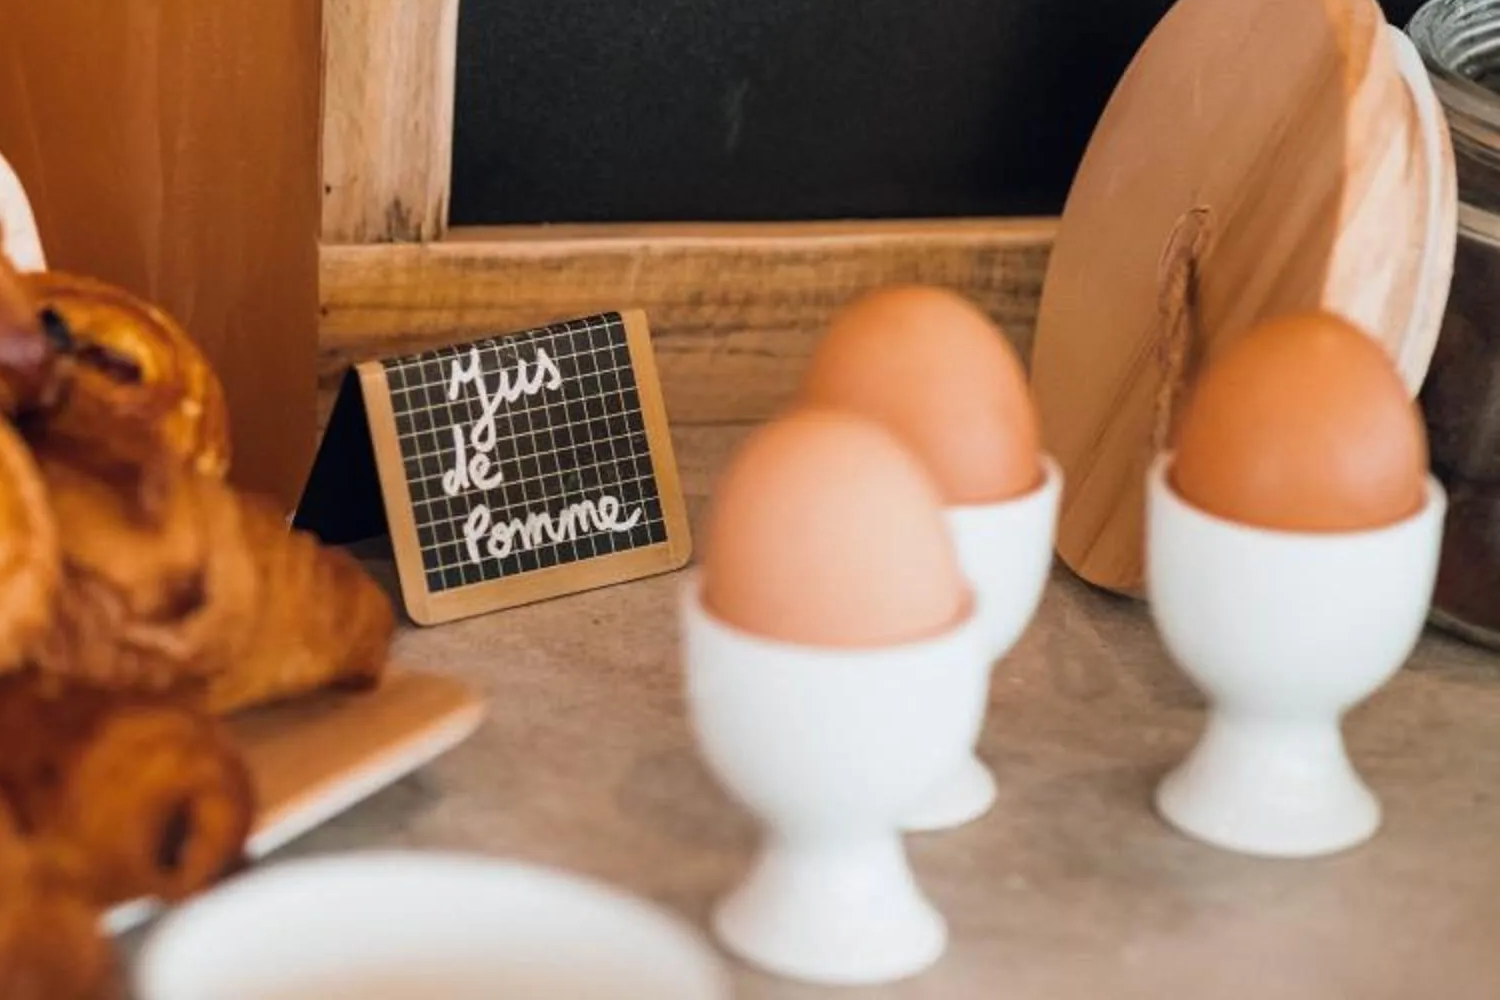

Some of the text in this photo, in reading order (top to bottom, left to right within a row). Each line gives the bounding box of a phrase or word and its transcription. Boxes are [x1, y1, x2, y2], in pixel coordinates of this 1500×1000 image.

[449, 347, 563, 453] Jus
[442, 426, 503, 497] de
[462, 494, 643, 564] Pomme
